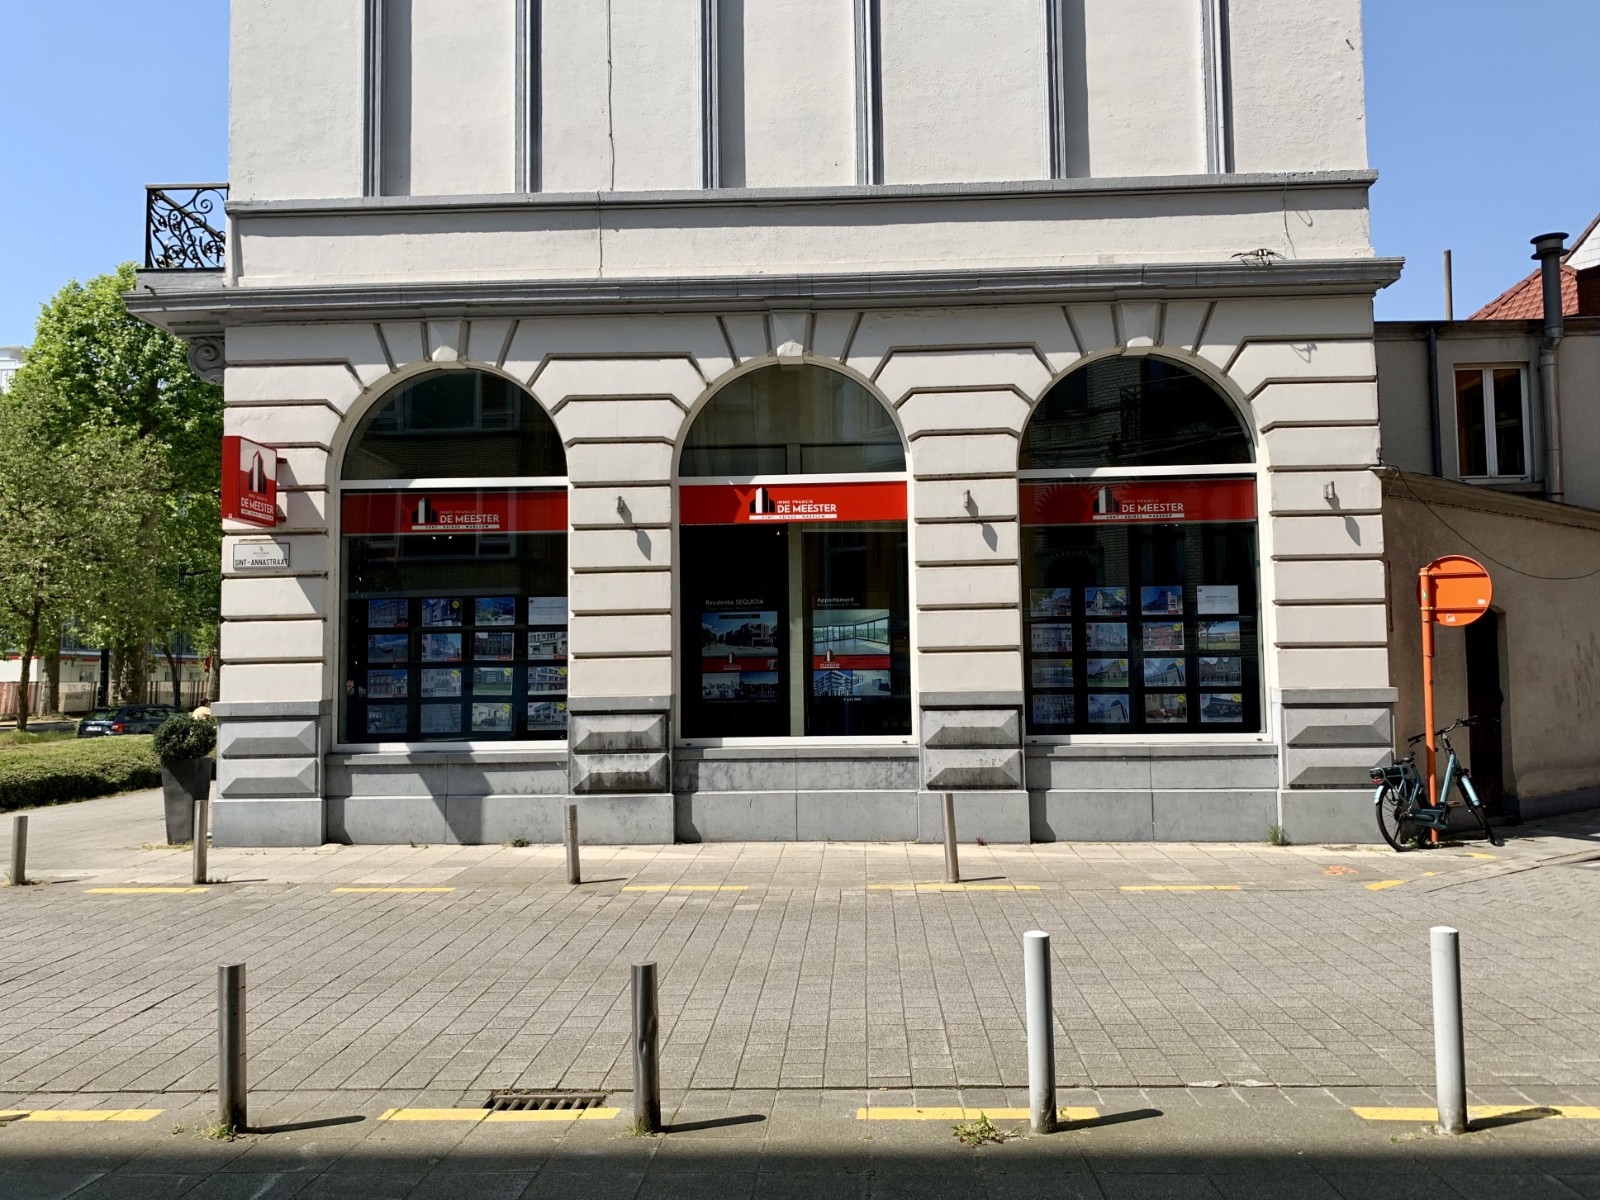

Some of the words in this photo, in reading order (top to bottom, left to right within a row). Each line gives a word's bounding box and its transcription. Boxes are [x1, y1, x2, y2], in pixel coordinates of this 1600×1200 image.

[241, 497, 249, 508] DE
[250, 500, 274, 514] MEESTER
[777, 504, 790, 513] DE
[792, 504, 836, 513] MEESTER
[1122, 504, 1135, 513] DE
[1137, 503, 1183, 512] MEESTER
[440, 514, 453, 523] DE
[455, 514, 499, 523] MEESTER
